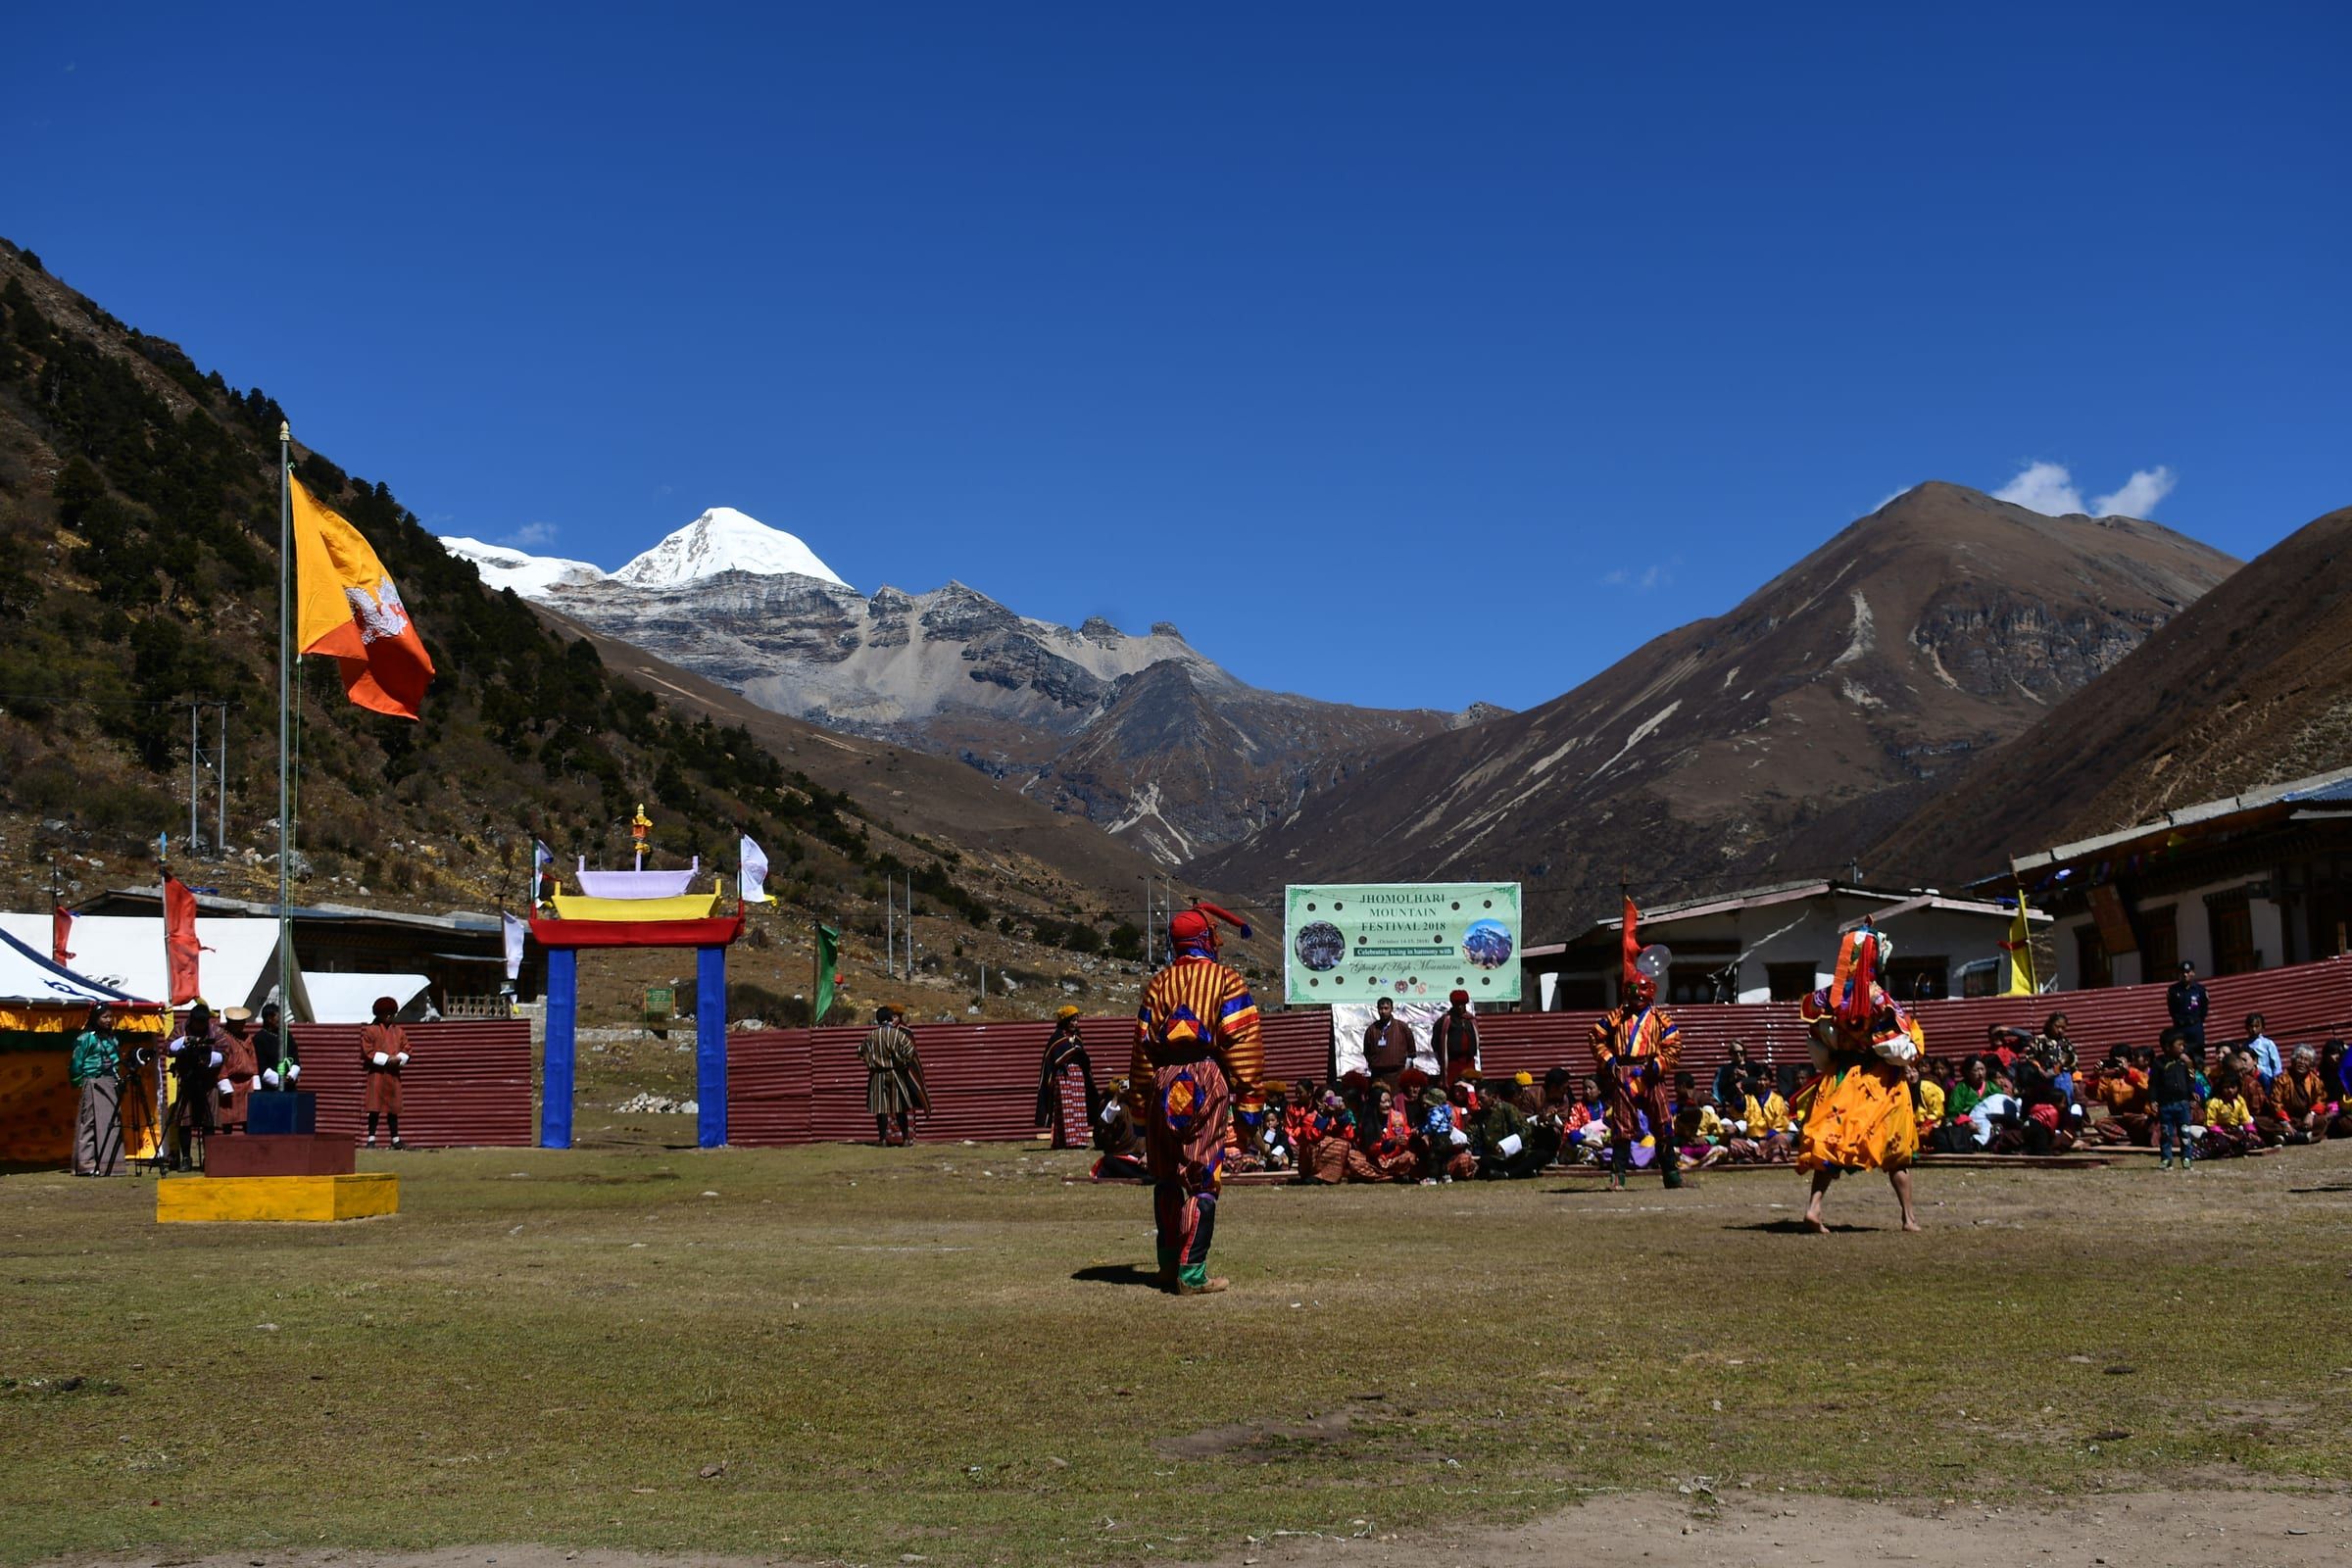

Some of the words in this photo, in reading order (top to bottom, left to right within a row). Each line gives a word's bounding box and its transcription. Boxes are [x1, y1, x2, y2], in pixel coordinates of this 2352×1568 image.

[1360, 894, 1445, 904] JHOMOLHARI
[1370, 908, 1437, 917] MOUNTAIN
[1361, 922, 1421, 931] FESTIVAL
[1423, 922, 1446, 931] 2018
[1356, 948, 1390, 956] Celebrating
[1390, 948, 1406, 956] living
[1413, 948, 1438, 956] harmony
[1389, 961, 1412, 975] High
